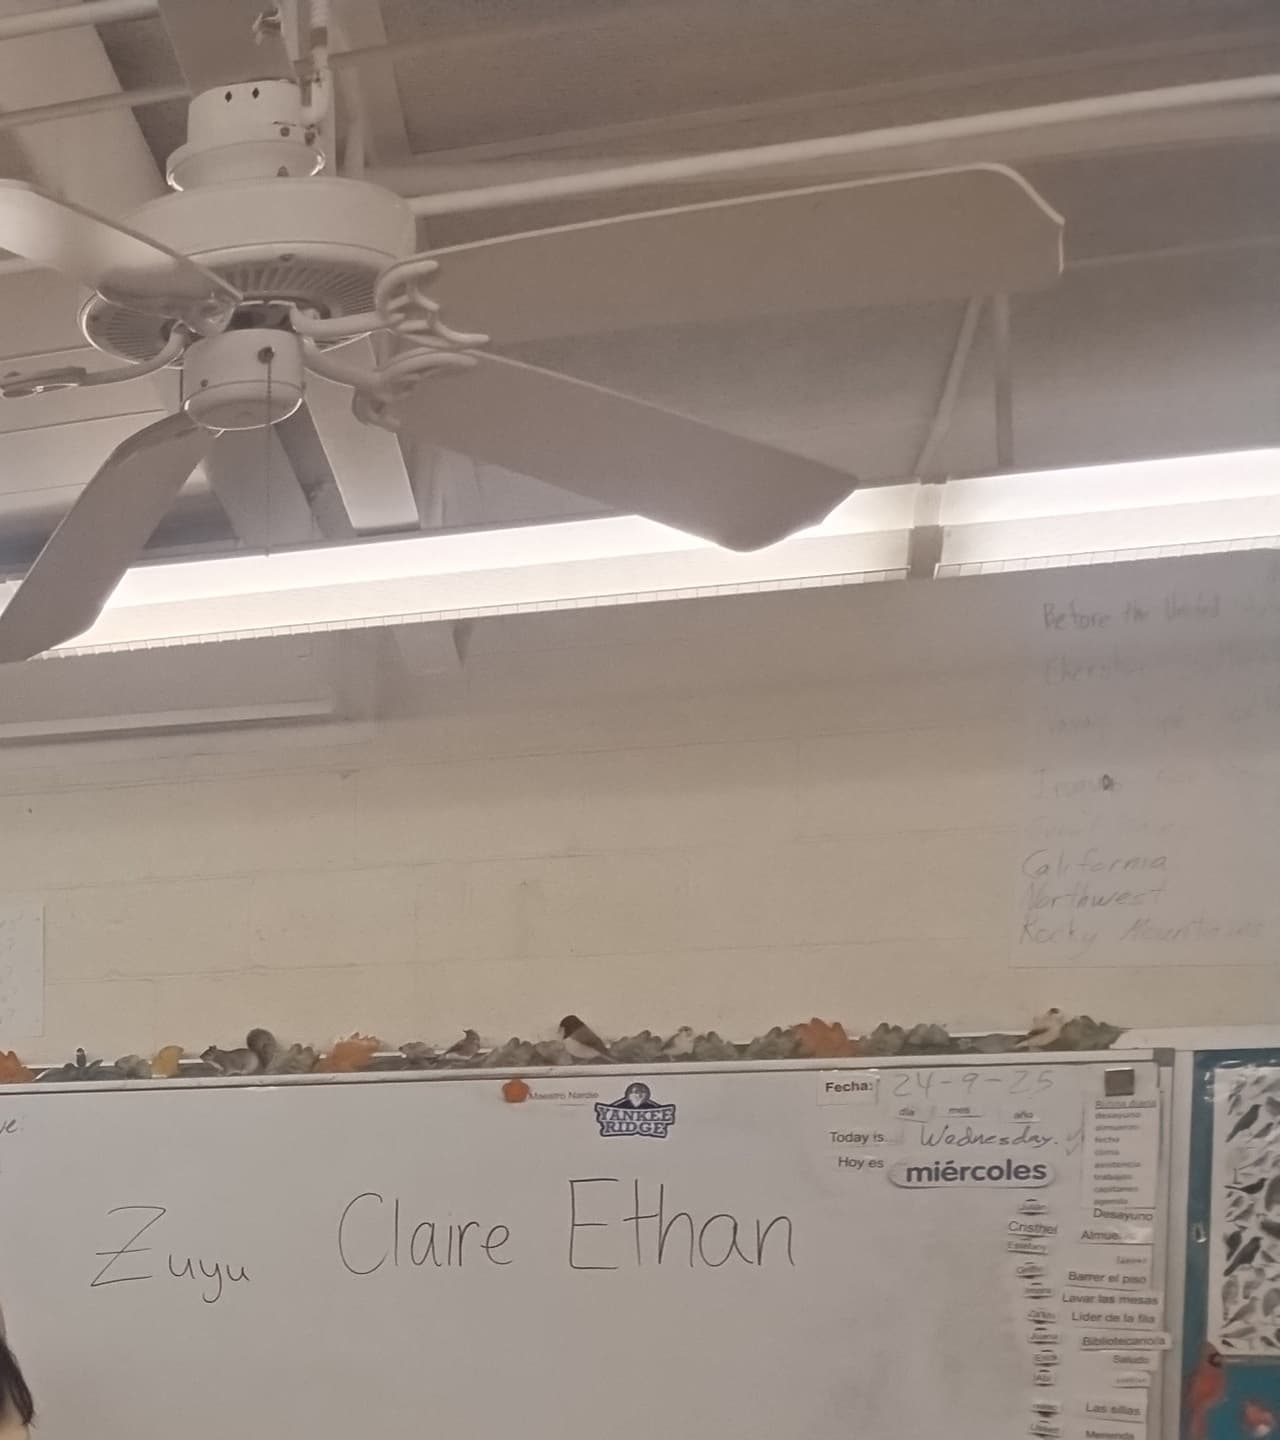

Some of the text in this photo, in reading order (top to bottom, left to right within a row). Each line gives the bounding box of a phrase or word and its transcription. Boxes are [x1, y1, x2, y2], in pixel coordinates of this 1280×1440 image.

[825, 1080, 873, 1093] Fecha:
[598, 1107, 674, 1121] YANKEE
[605, 1121, 665, 1134] RIDGE
[830, 1131, 870, 1145] Today
[838, 1157, 885, 1170] Hoy es
[906, 1159, 1047, 1183] miércoles
[1093, 1208, 1153, 1222] Desayuno
[569, 1178, 794, 1269] Ethan
[339, 1192, 513, 1275] Claire
[91, 1205, 251, 1303] Zuyu
[1068, 1271, 1146, 1284] Barrer el piso
[1062, 1293, 1158, 1306] Lavar las mesas
[1105, 1312, 1120, 1322] de
[1123, 1313, 1135, 1323] la
[1085, 1402, 1141, 1416] Las sillas
